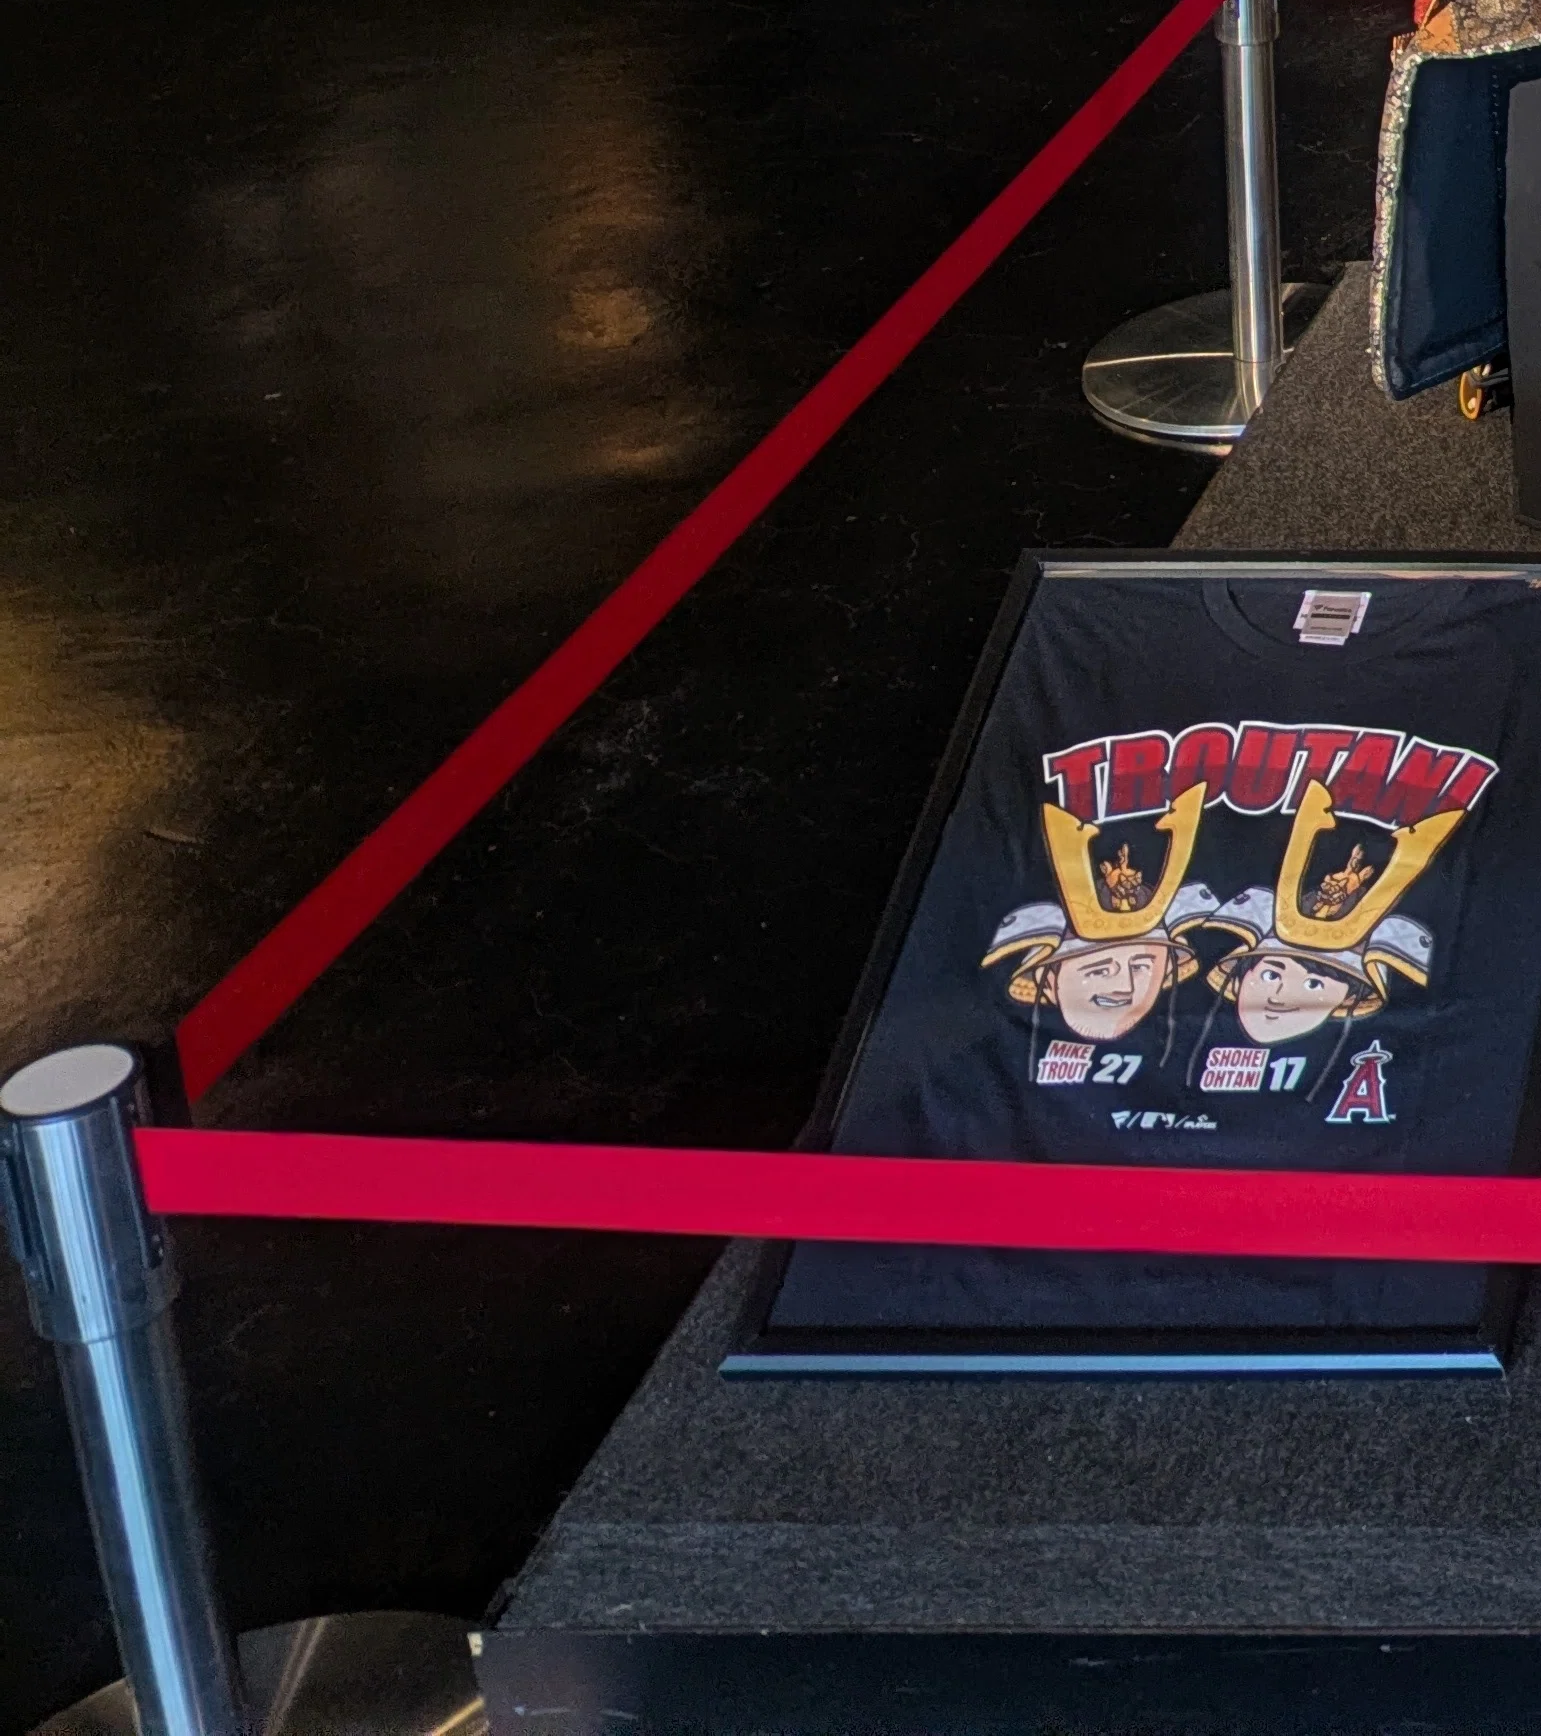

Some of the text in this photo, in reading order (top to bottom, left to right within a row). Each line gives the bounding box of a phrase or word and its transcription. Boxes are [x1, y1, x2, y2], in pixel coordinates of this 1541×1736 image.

[1043, 721, 1499, 830] TROUTANI
[1039, 1060, 1088, 1082] TROUT
[1050, 1042, 1142, 1084] MIKE 27
[1202, 1069, 1262, 1090] OHTANI
[1208, 1048, 1306, 1091] SHOHEI 17
[1325, 1040, 1394, 1123] A
